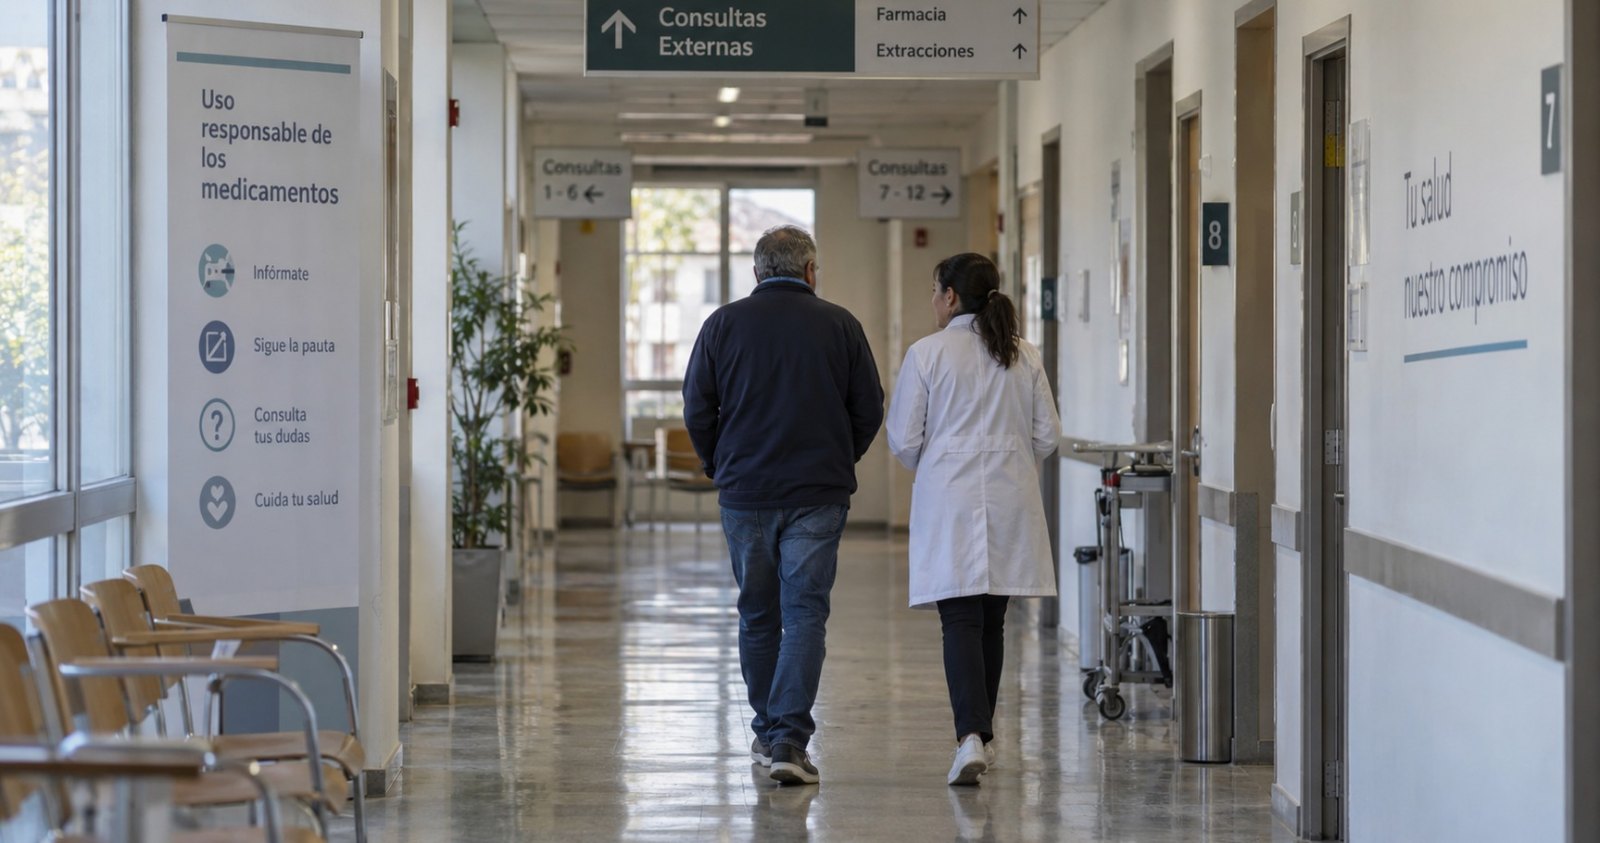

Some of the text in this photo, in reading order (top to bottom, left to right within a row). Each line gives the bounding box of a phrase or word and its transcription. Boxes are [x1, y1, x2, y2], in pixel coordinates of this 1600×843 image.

[659, 7, 767, 27] Consultas
[876, 6, 946, 21] Farmacia
[659, 36, 754, 56] Externas
[876, 43, 974, 58] Extracciones
[202, 89, 235, 110] Uso
[1545, 92, 1556, 149] 7
[202, 121, 332, 145] responsable de
[202, 146, 227, 168] los
[542, 158, 622, 176] Consultas
[867, 158, 947, 176] Consultas
[202, 177, 339, 205] medicamentos
[544, 184, 552, 200] 1
[567, 184, 578, 201] 6
[880, 184, 891, 201] 7
[907, 184, 925, 201] 12
[1404, 171, 1417, 230] Tu
[1421, 151, 1452, 226] salud
[1208, 220, 1222, 250] 8
[253, 264, 310, 281] Infórmate
[1404, 261, 1446, 319] nuestro
[1449, 235, 1528, 325] compromiso
[253, 337, 336, 356] Sigue la pauta
[254, 406, 307, 422] Consulta
[254, 428, 311, 444] tus dudas
[254, 489, 339, 508] Cuida tu salud
